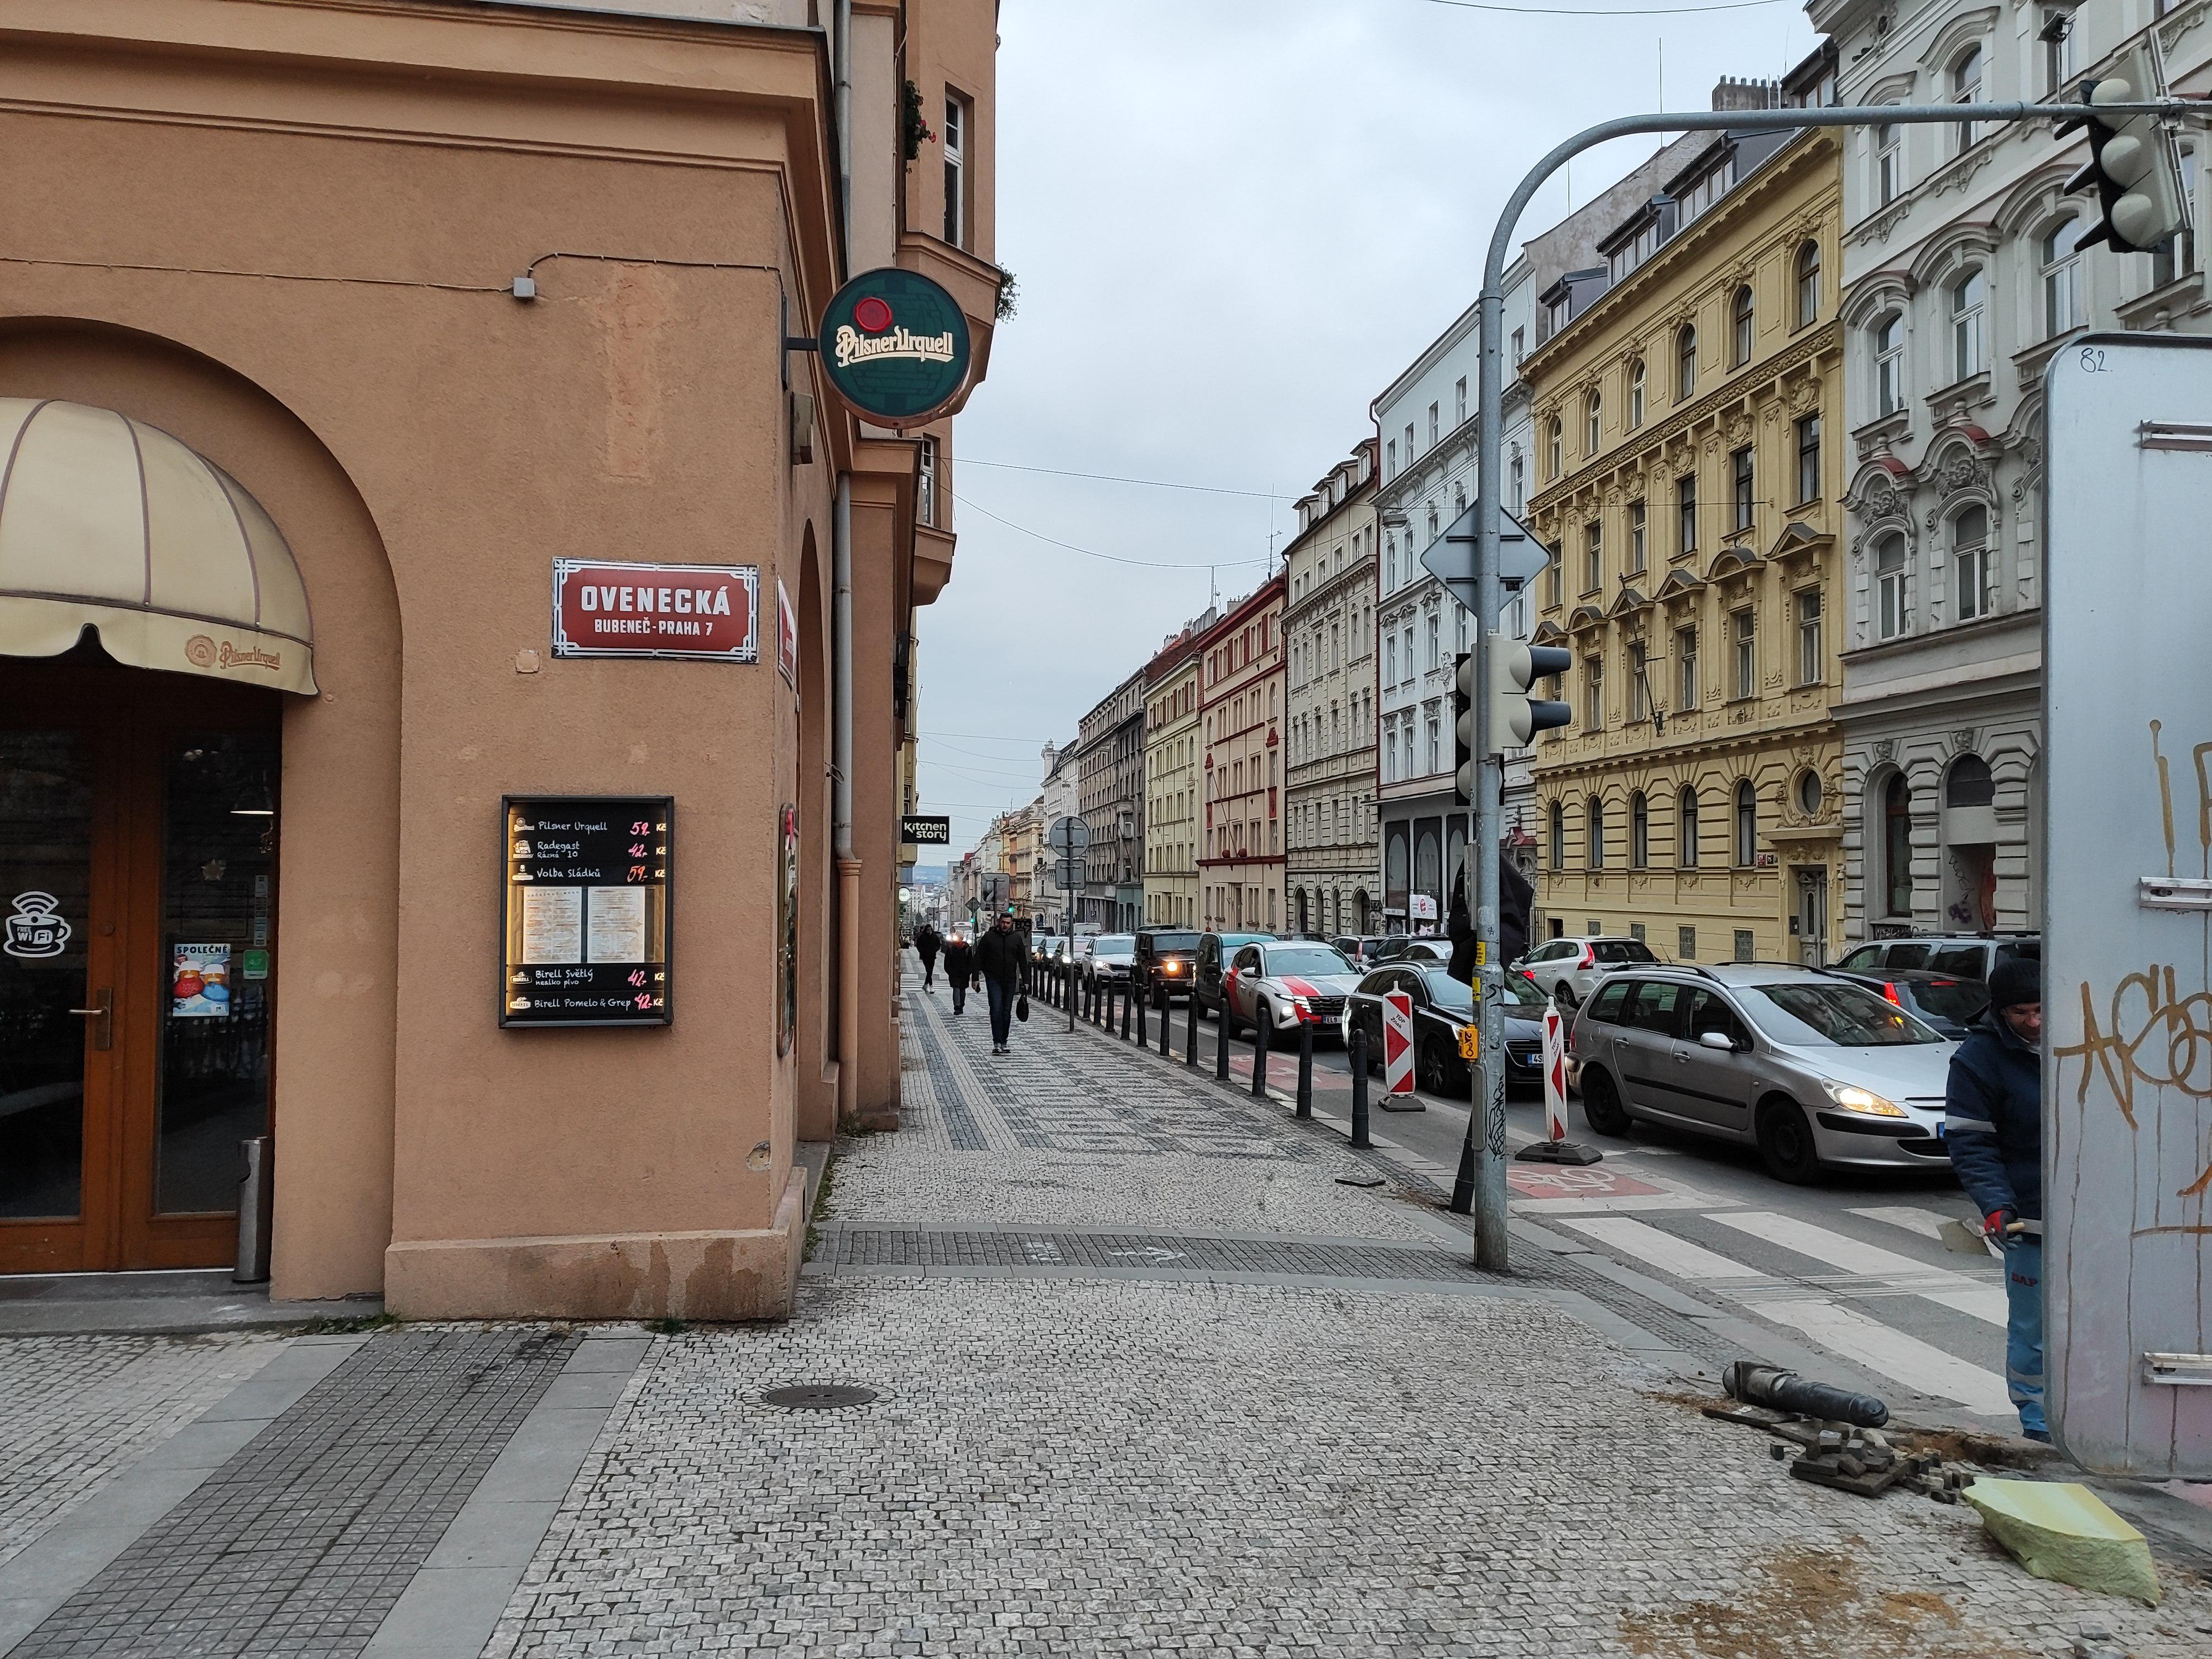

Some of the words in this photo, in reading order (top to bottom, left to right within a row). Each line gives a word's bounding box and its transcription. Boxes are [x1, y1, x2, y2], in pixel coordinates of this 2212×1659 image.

[836, 325, 896, 367] Pilsner
[894, 325, 953, 362] Urquell
[2080, 347, 2107, 373] 82
[581, 586, 731, 616] OVENECKÁ
[705, 622, 713, 636] 7
[220, 641, 254, 669] Pilsner
[253, 646, 280, 669] Urquell
[538, 821, 571, 830] Pilsner
[575, 821, 607, 835] Urquell
[904, 822, 947, 833] Kitchen
[916, 830, 947, 841] story
[538, 839, 580, 852] Radegast
[536, 868, 564, 878] Volba
[567, 867, 601, 878] Sládků
[535, 970, 562, 978] Birell
[566, 968, 593, 982] Světlý
[564, 999, 598, 1007] Pomelo
[600, 999, 606, 1008] &
[608, 999, 631, 1011] Grep
[653, 998, 663, 1006] Kč
